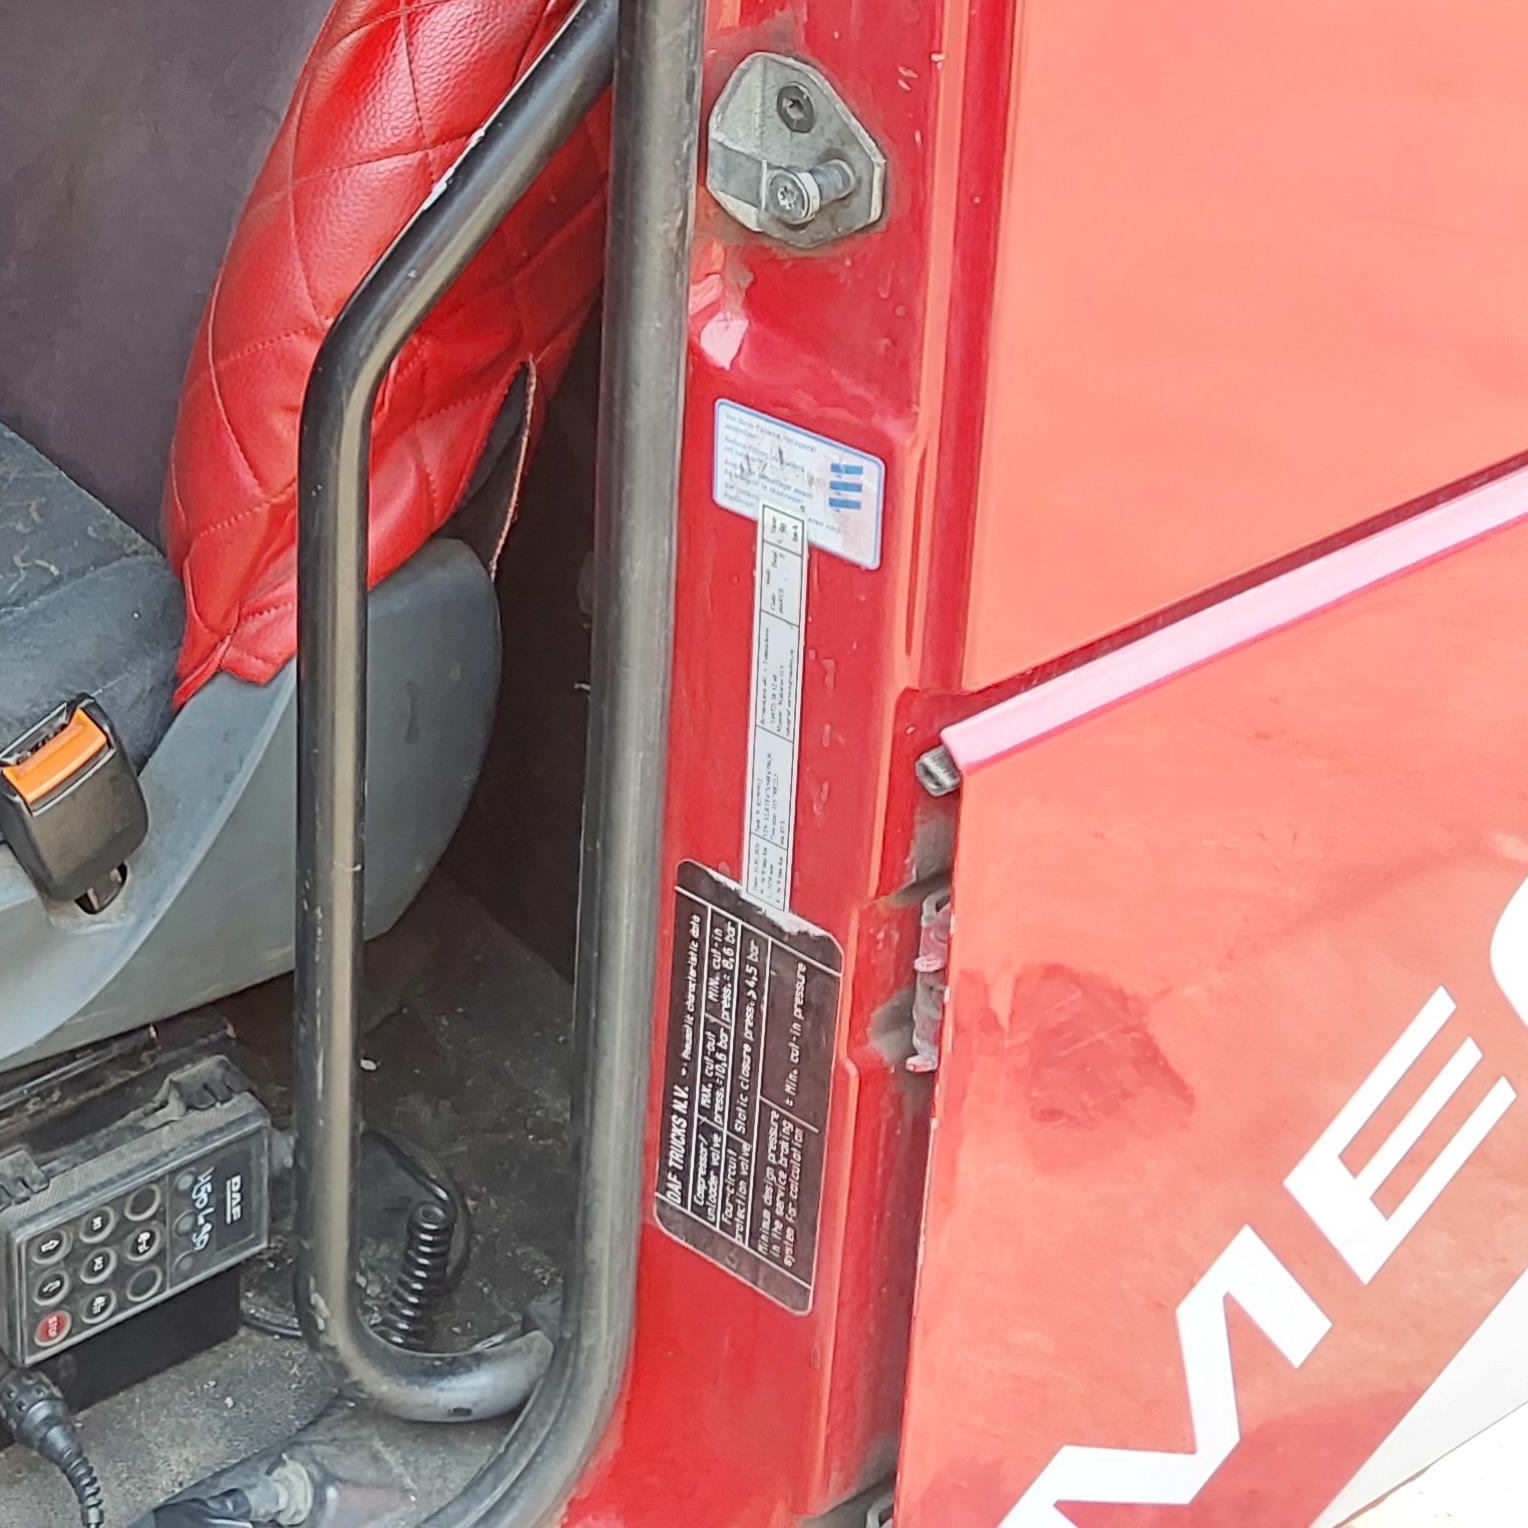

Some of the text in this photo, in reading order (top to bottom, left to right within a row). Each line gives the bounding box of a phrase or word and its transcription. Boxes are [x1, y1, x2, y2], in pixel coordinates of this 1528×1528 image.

[723, 918, 736, 945] bar
[747, 937, 759, 964] bar
[708, 925, 723, 1003] MIN. cut-in
[792, 959, 809, 1021] pressure
[716, 1025, 728, 1051] bar
[786, 1018, 802, 1065] cut-in
[700, 1029, 716, 1110] MAX. cut-out
[738, 1040, 752, 1091] closure
[671, 1078, 689, 1116] N.V.
[734, 1090, 748, 1135] Static
[667, 1111, 687, 1174] TRUCKS
[766, 1108, 781, 1165] pressure
[777, 1117, 794, 1170] braking
[666, 1168, 682, 1205] DAF
[705, 1130, 721, 1223] unloader valve
[721, 1146, 737, 1226] Four-circuit
[761, 1163, 776, 1208] design
[787, 1125, 804, 1201] calculation
[231, 1175, 241, 1222] DAF
[732, 1140, 750, 1245] protection valve
[773, 1167, 787, 1218] service
[771, 1216, 782, 1241] the
[781, 1223, 798, 1270] system
[48, 1316, 57, 1337] STOP
